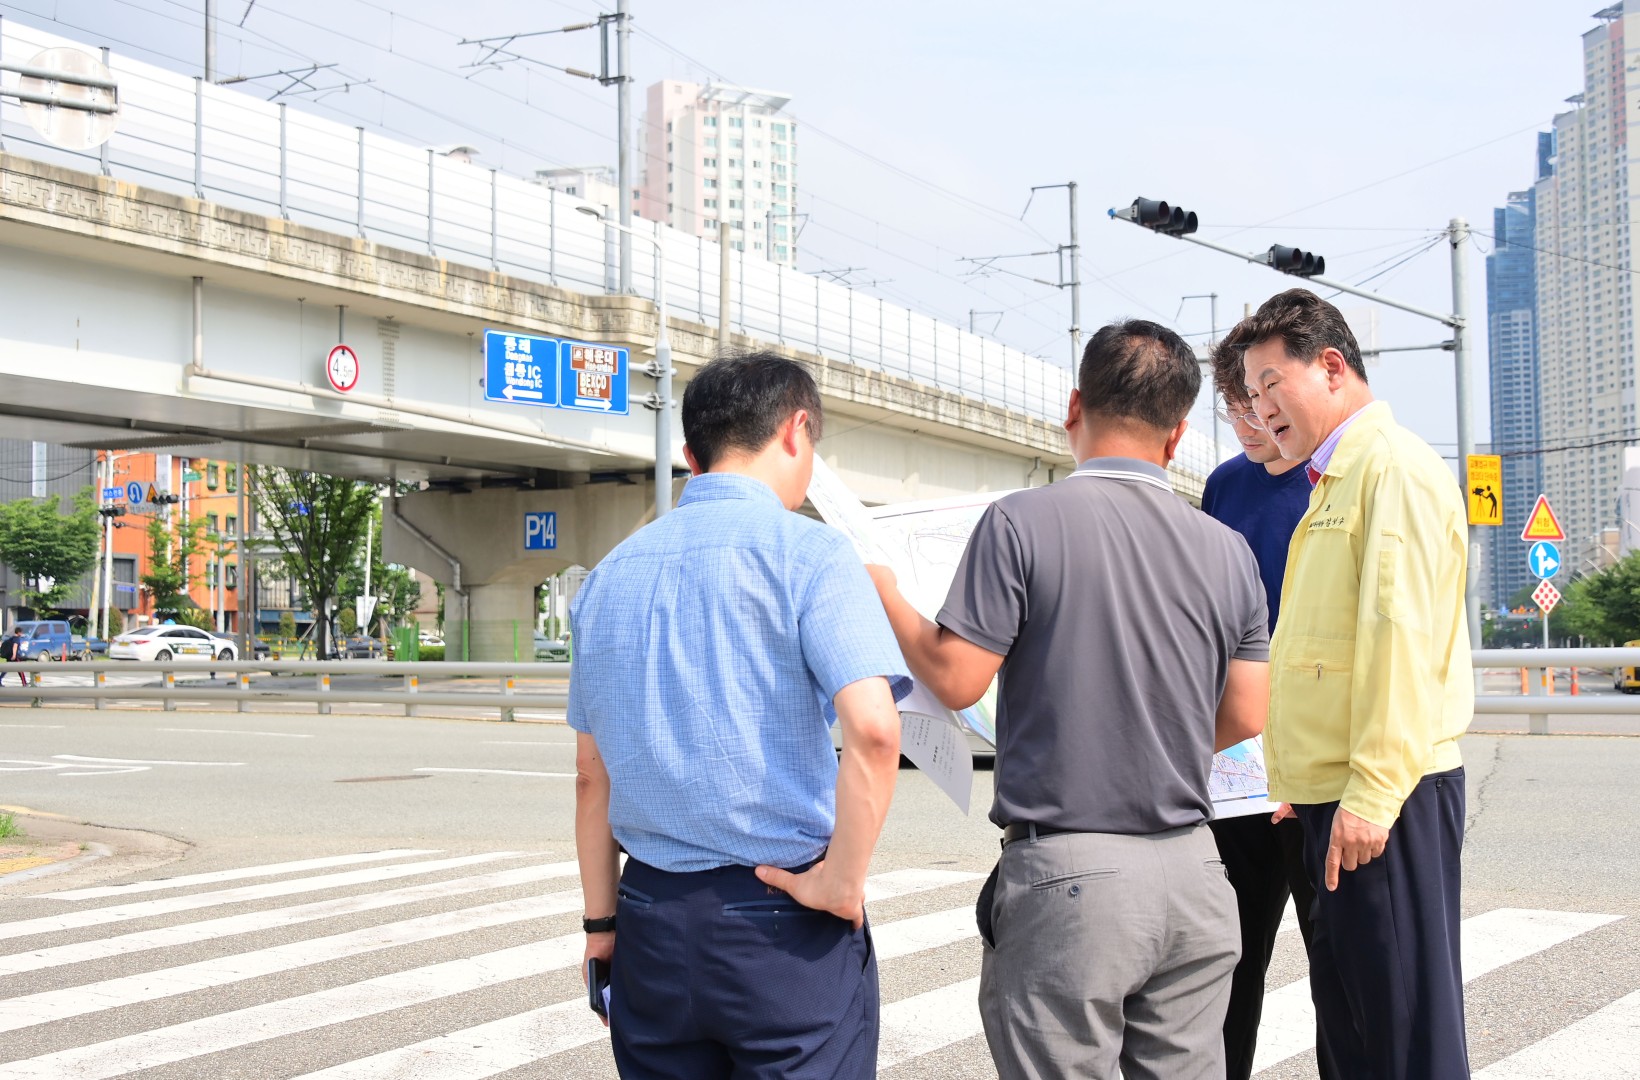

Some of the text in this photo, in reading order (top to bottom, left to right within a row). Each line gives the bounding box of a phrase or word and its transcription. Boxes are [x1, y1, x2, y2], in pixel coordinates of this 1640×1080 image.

[504, 337, 531, 354] 동래
[584, 348, 614, 366] 해운대
[580, 373, 607, 390] BEXCO
[580, 387, 601, 398] 벡스코
[526, 514, 555, 548] P14
[1536, 517, 1550, 528] 위험
